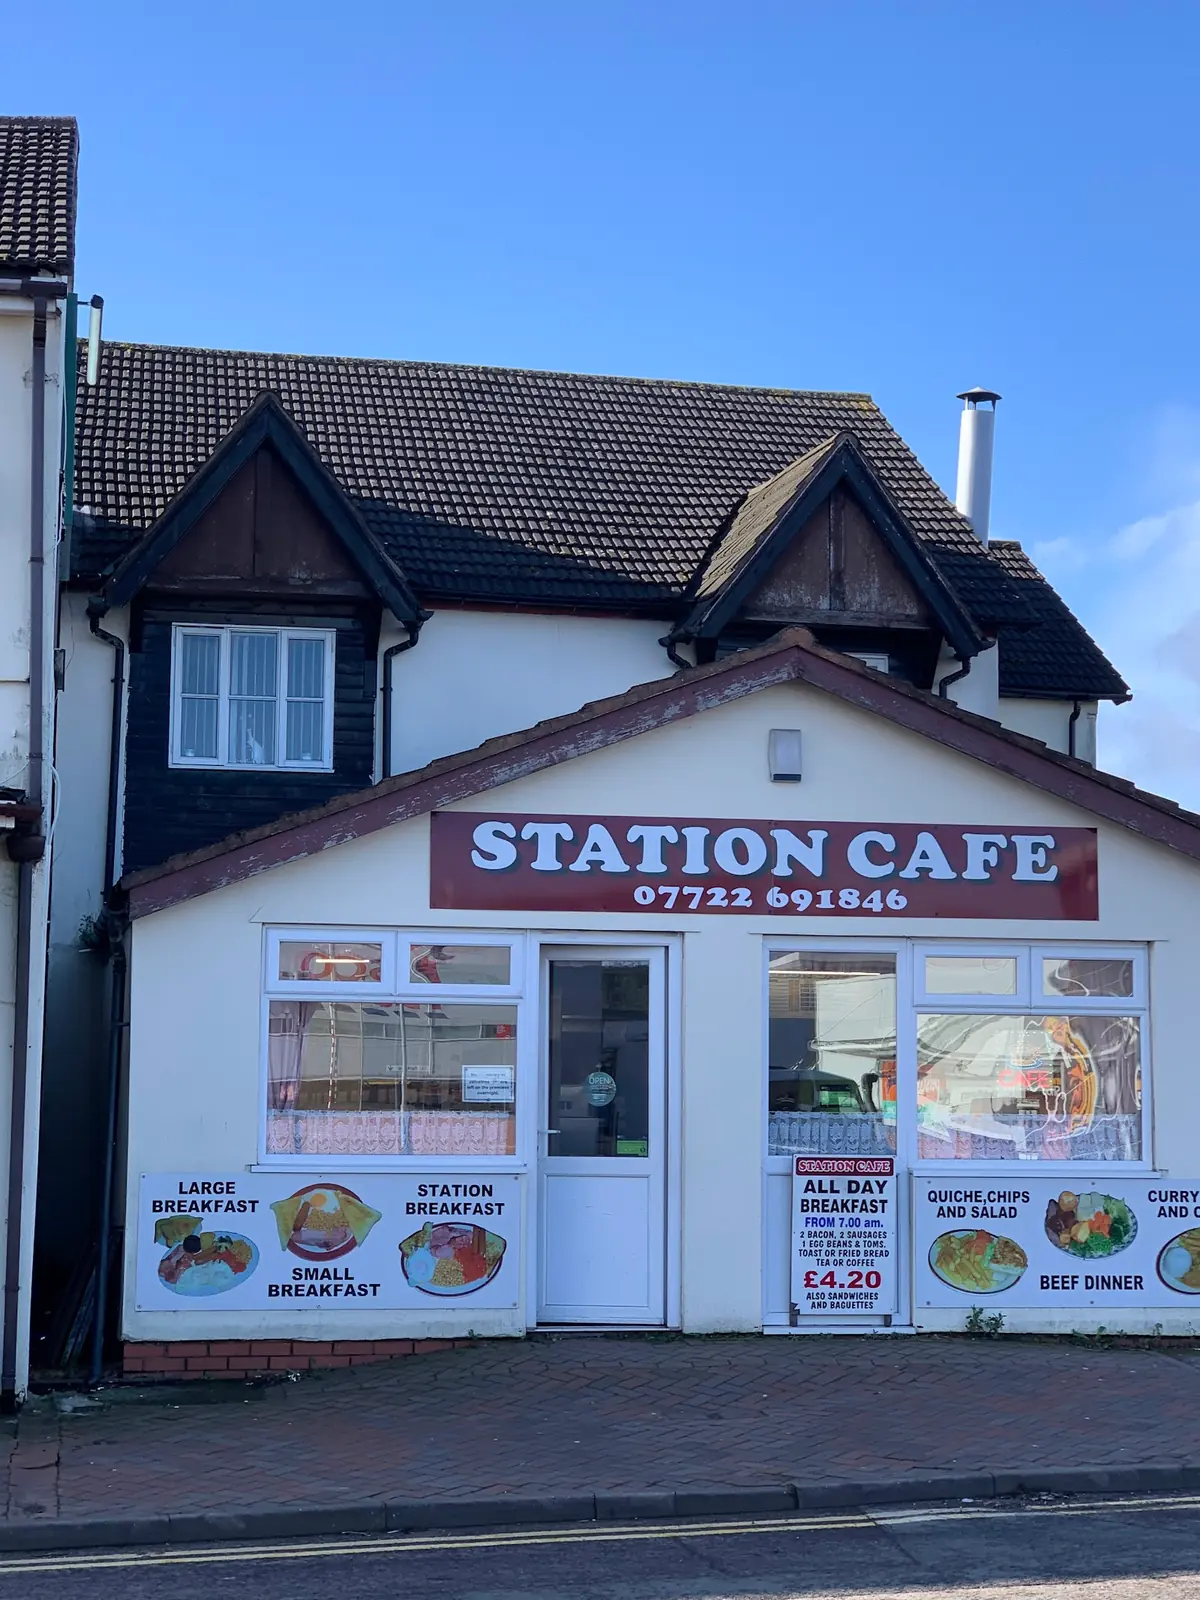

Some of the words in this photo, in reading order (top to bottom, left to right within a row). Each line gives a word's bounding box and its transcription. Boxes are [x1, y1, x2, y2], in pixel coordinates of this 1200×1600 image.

[471, 820, 829, 878] STATION
[847, 829, 1060, 882] CAFE
[634, 885, 752, 909] 07722
[766, 886, 909, 912] 691846
[588, 1076, 610, 1085] OPEN
[798, 1159, 855, 1173] STATION
[856, 1160, 891, 1174] CAFE
[178, 1181, 236, 1195] LARGE
[417, 1184, 494, 1198] STATION
[803, 1179, 840, 1194] ALL
[847, 1179, 889, 1195] DAY
[927, 1190, 1030, 1206] QUICHE,CHIPS
[1148, 1190, 1200, 1202] CURRY
[151, 1199, 260, 1213] BREAKFAST
[405, 1202, 505, 1216] BREAKFAST
[800, 1198, 889, 1214] BREAKFAST
[936, 1206, 967, 1218] AND
[971, 1206, 1018, 1218] SALAD
[1157, 1206, 1189, 1218] AND
[804, 1216, 835, 1228] FROM
[838, 1217, 861, 1228] 7.00
[864, 1219, 884, 1228] am.
[807, 1231, 836, 1240] BACON,
[847, 1231, 888, 1239] SAUSAGES
[808, 1240, 824, 1248] EGG
[826, 1240, 852, 1248] BEANS
[854, 1240, 860, 1248] &
[862, 1240, 886, 1248] TOMS.
[798, 1249, 822, 1258] TOAST
[824, 1250, 836, 1258] OR
[838, 1250, 861, 1258] FRIED
[864, 1250, 890, 1258] BREAD
[816, 1258, 830, 1266] TEA
[846, 1258, 874, 1266] COFFEE
[292, 1267, 355, 1281] SMALL
[804, 1270, 882, 1289] £4.20
[1040, 1275, 1080, 1290] BEEF
[1084, 1275, 1144, 1290] DINNER
[268, 1284, 381, 1297] BREAKFAST
[806, 1292, 826, 1300] ALSO
[828, 1292, 878, 1300] SANDWICHES
[810, 1301, 828, 1310] AND
[830, 1301, 874, 1310] BAGUETTES
